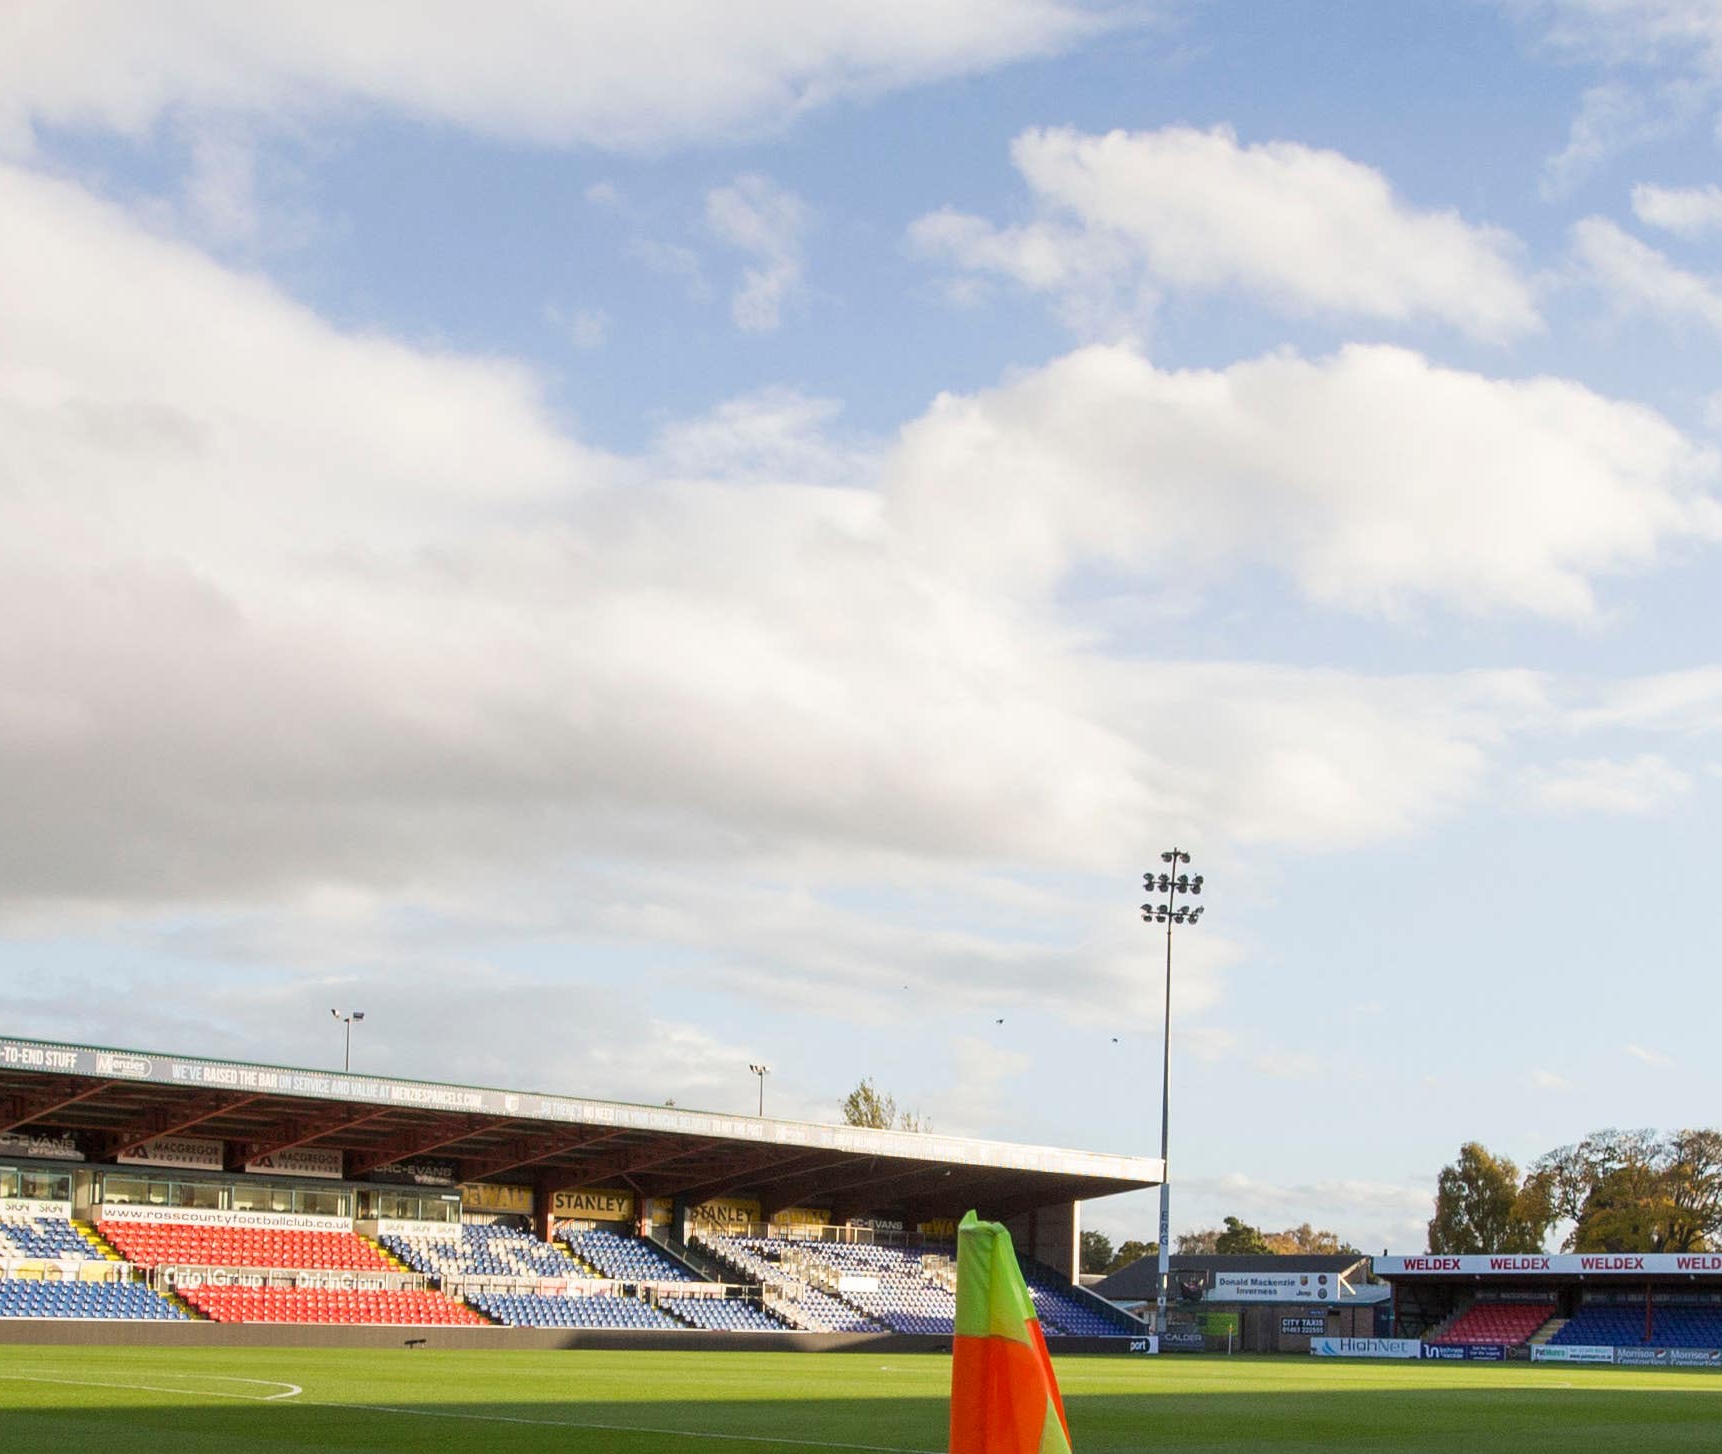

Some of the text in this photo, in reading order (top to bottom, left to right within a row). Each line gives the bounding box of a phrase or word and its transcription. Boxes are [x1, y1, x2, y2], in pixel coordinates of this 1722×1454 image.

[45, 1050, 76, 1068] STUFF
[204, 1066, 237, 1084] RAISED
[239, 1070, 257, 1086] THE
[259, 1072, 277, 1088] BAR
[153, 1141, 219, 1157] MACGREGOR
[278, 1149, 338, 1164] MACGREGOR
[556, 1194, 625, 1212] STANLEY
[104, 1206, 350, 1230] www.rosscountyfootballclub.co.uk
[1160, 1210, 1169, 1246] ERG
[1403, 1258, 1460, 1271] WELDEX
[1490, 1258, 1549, 1271] WELDEX
[1581, 1258, 1643, 1270] WELDEX
[1219, 1277, 1295, 1287] Donald Mackenzie
[1237, 1286, 1277, 1295] Inverness
[1165, 1333, 1202, 1342] CALDER
[1130, 1341, 1146, 1352] port
[1340, 1339, 1406, 1352] HighNet
[1617, 1349, 1655, 1358] Morrison
[1670, 1349, 1710, 1359] Morrison
